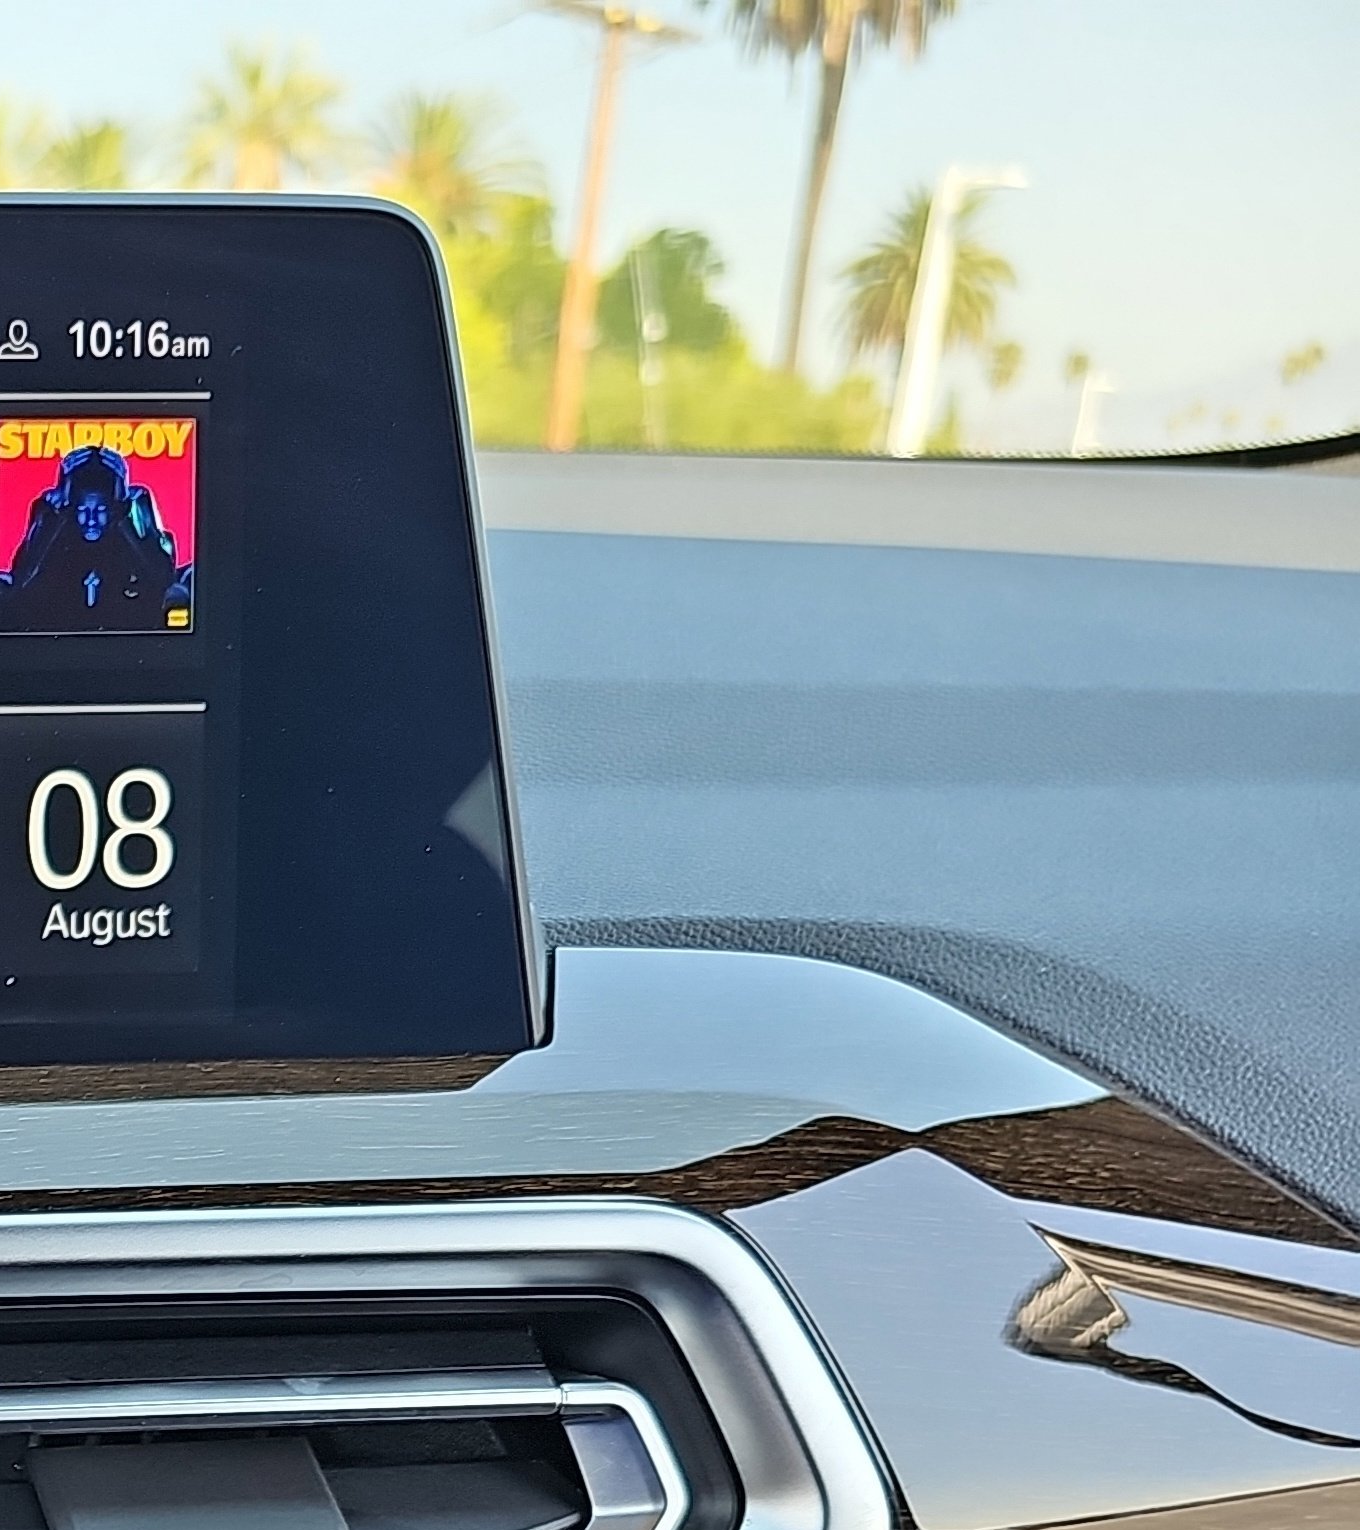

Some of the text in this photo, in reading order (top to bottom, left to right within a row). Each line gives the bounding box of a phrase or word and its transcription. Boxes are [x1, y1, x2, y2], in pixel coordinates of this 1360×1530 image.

[69, 320, 210, 358] 10:16am
[25, 767, 176, 892] 08
[40, 901, 172, 947] August
